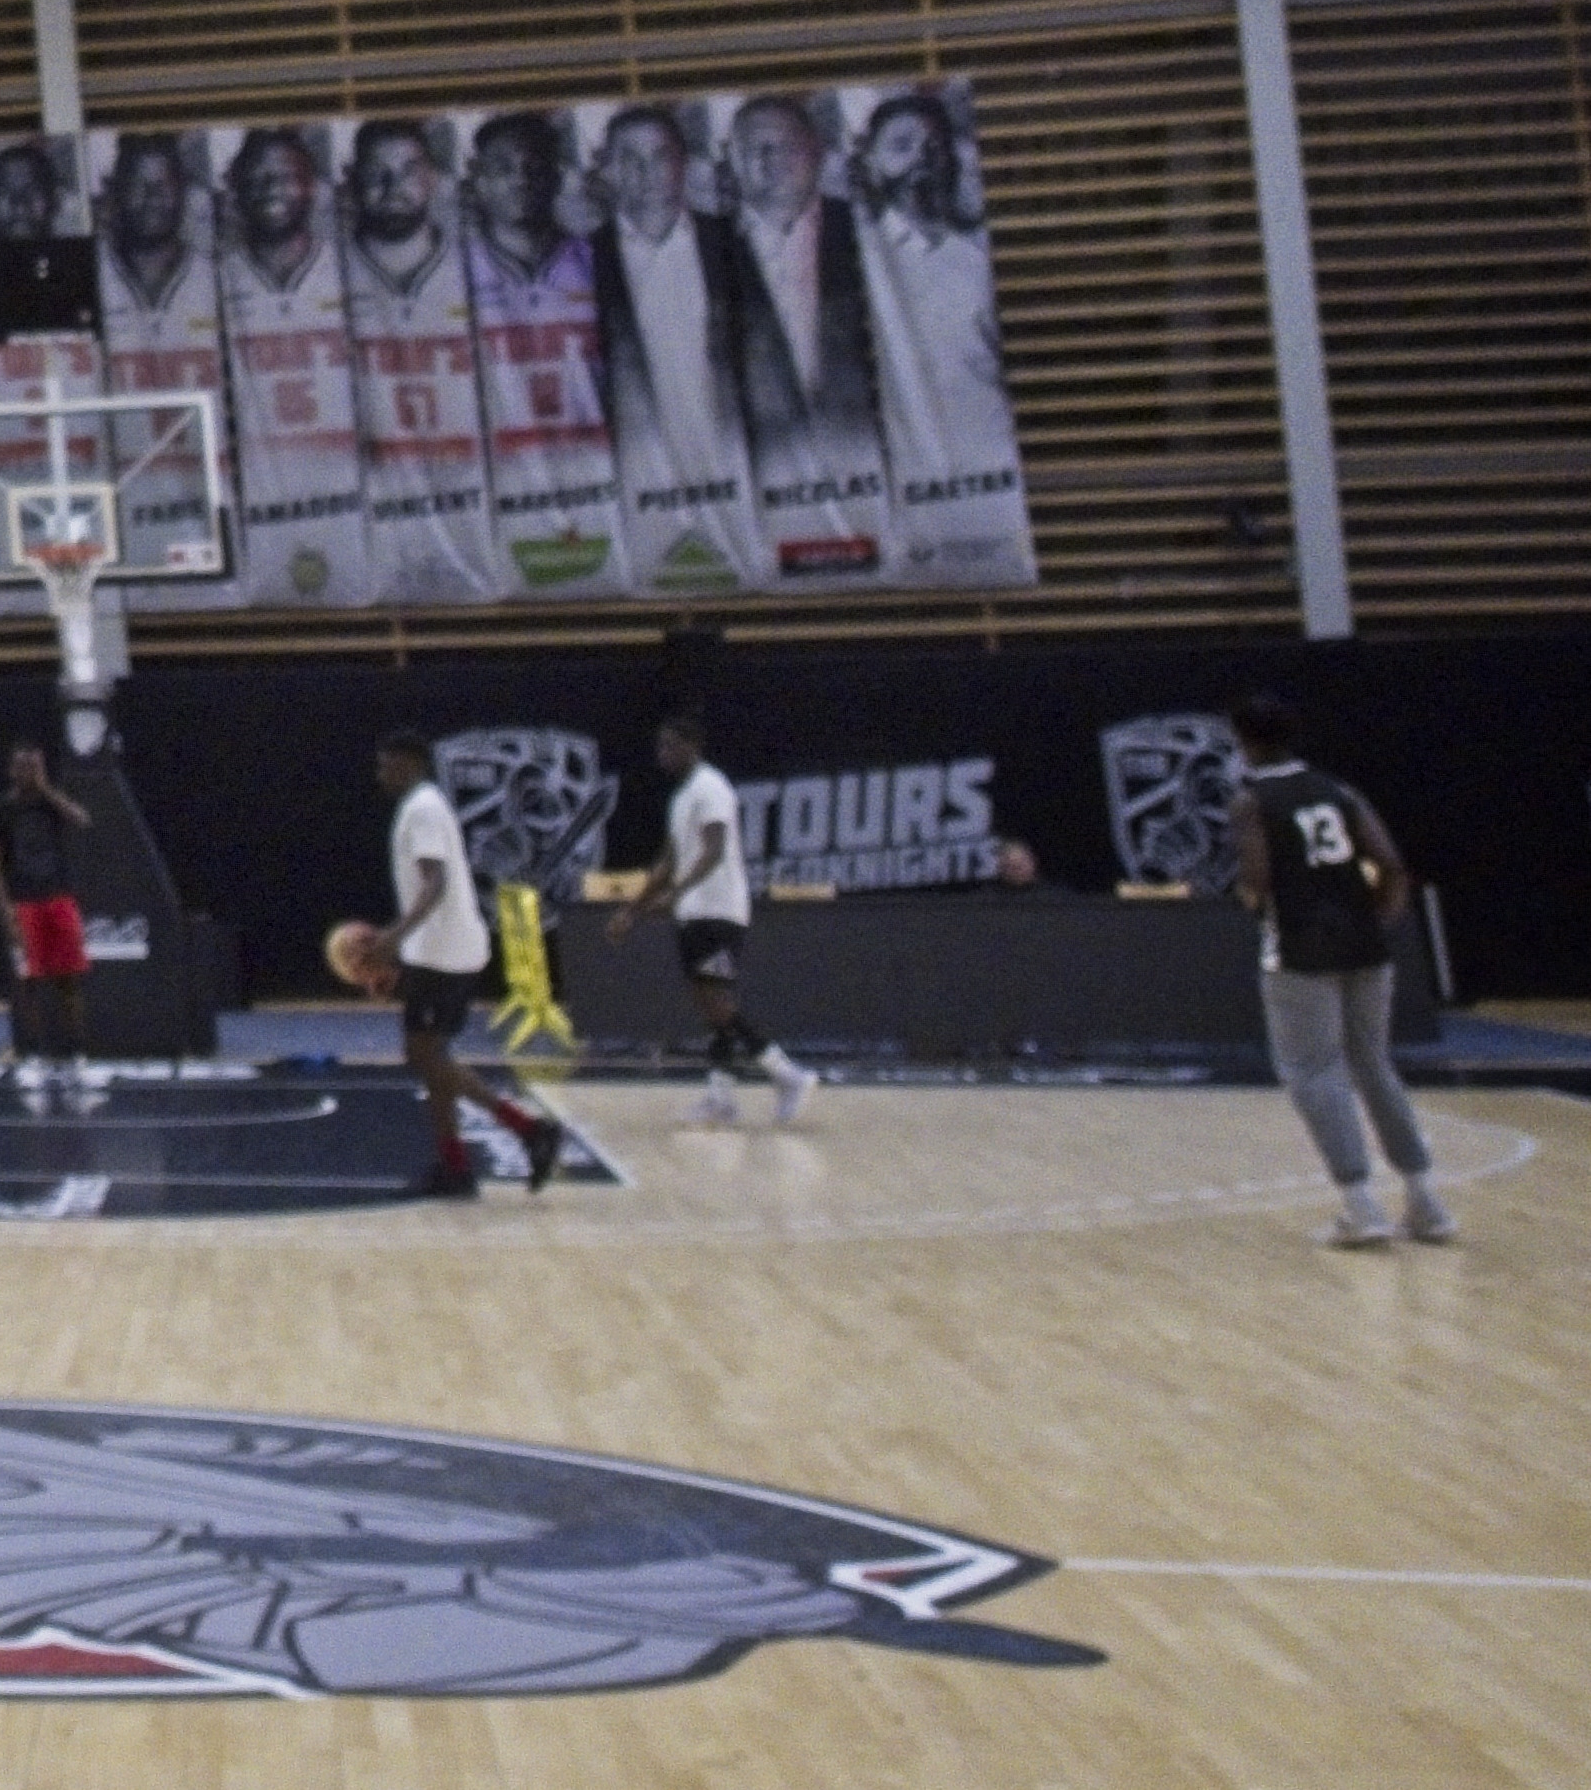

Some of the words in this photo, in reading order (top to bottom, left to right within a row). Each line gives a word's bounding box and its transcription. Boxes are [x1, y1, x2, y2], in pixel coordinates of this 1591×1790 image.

[638, 478, 737, 509] PIERRE
[763, 473, 880, 506] NICOLAS
[736, 758, 995, 858] TOURS
[1295, 805, 1353, 868] 13
